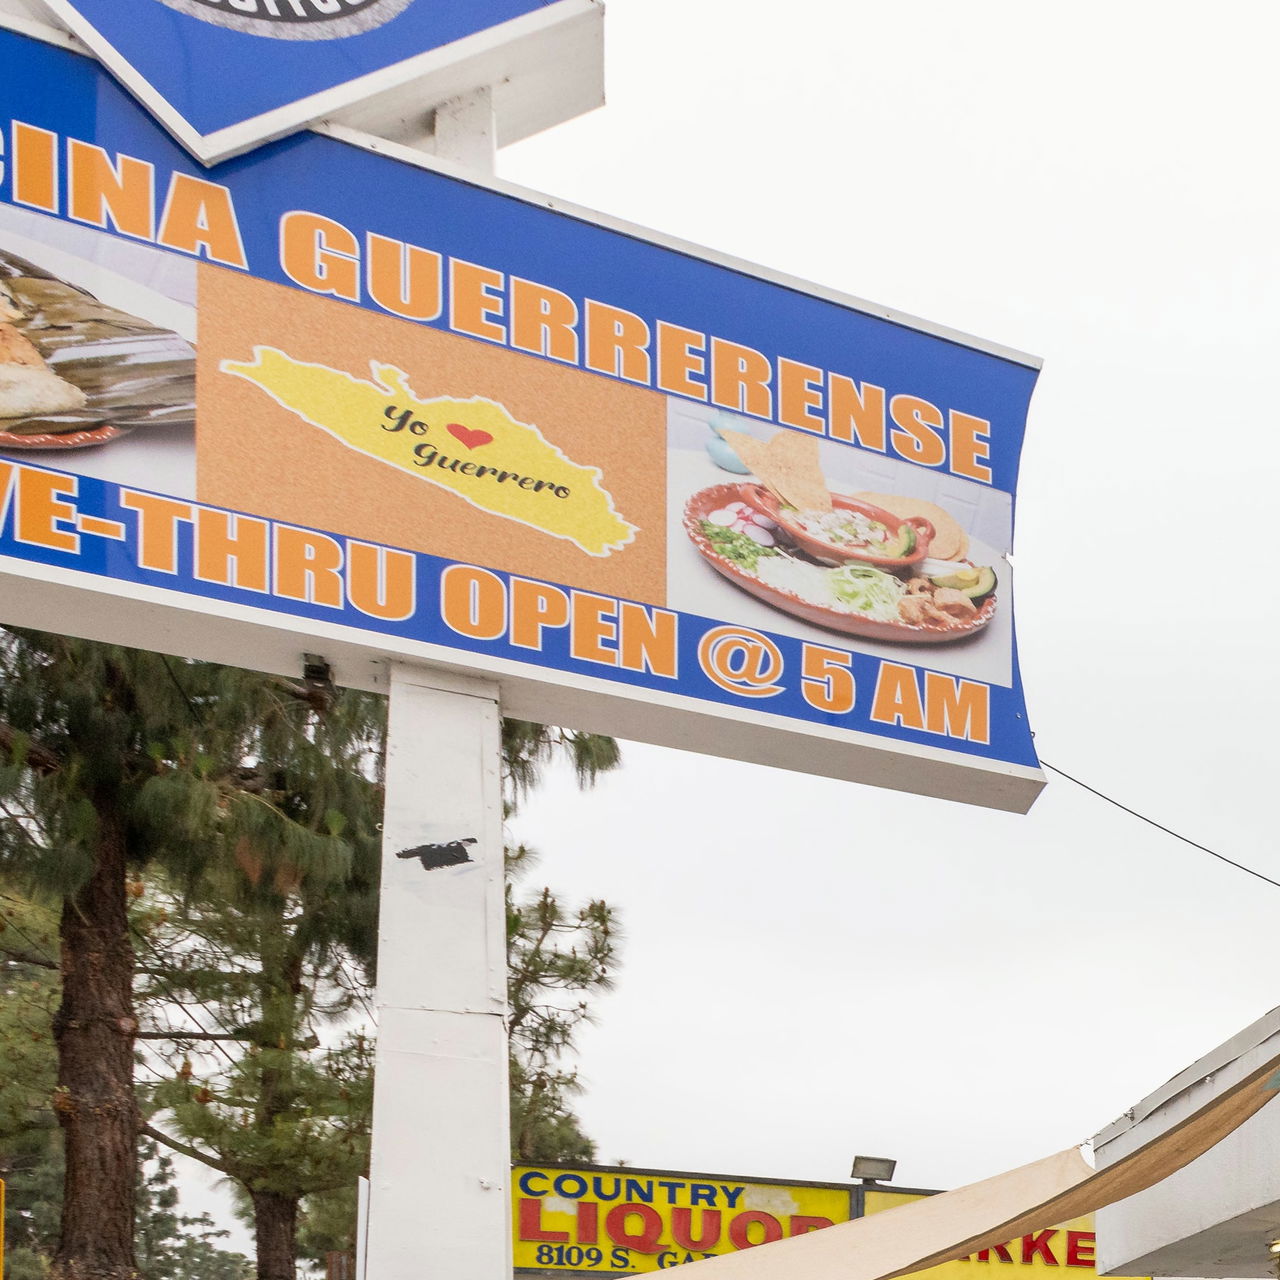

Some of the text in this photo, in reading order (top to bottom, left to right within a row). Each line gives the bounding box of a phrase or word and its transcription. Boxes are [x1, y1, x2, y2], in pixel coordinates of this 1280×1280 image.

[0, 118, 993, 484] INA GUERRERENSE
[380, 403, 429, 438] Yo
[413, 442, 572, 501] Guerrero
[440, 564, 679, 680] OPEN
[698, 625, 787, 698] @
[801, 641, 856, 715] 5
[869, 659, 991, 746] AM
[519, 1171, 744, 1209] COUNTRY
[536, 1244, 602, 1267] 8109
[610, 1248, 635, 1269] S.
